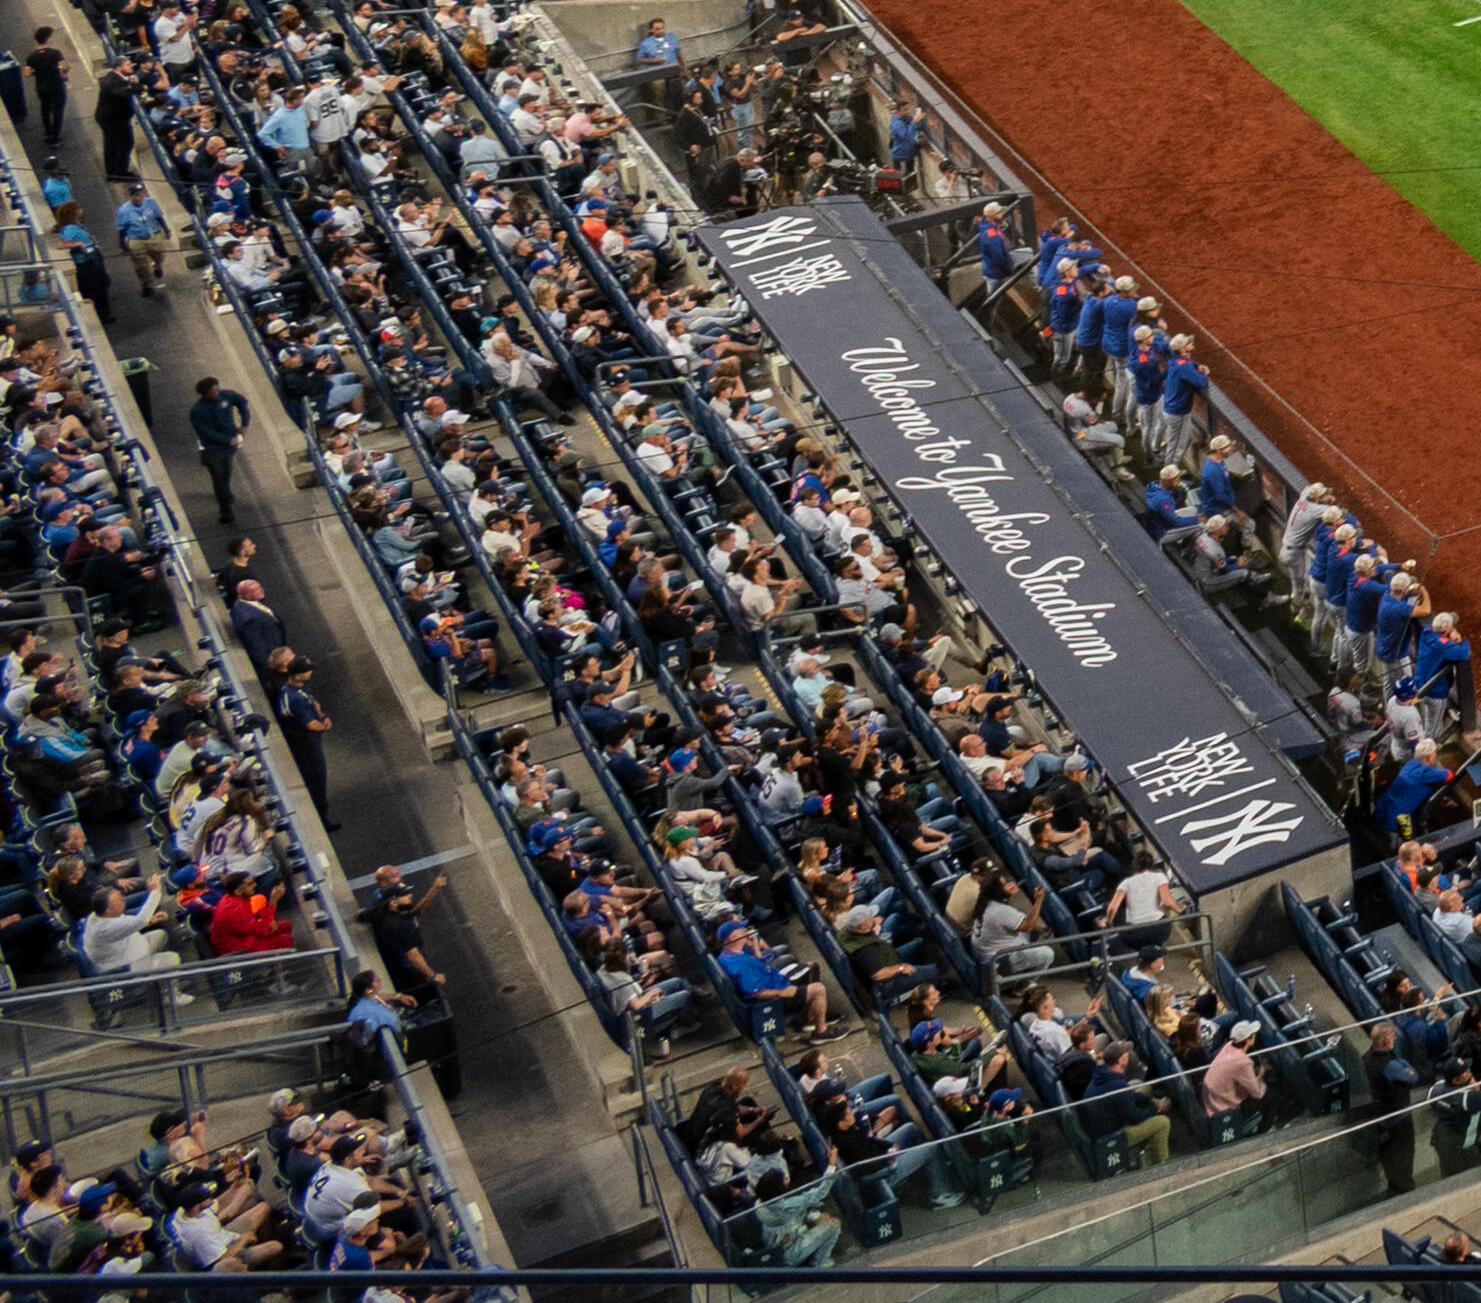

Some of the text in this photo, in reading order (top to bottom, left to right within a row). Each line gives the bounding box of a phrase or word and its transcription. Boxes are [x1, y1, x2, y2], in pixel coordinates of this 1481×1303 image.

[840, 337, 1118, 669] Welcome to Yankee Stadium
